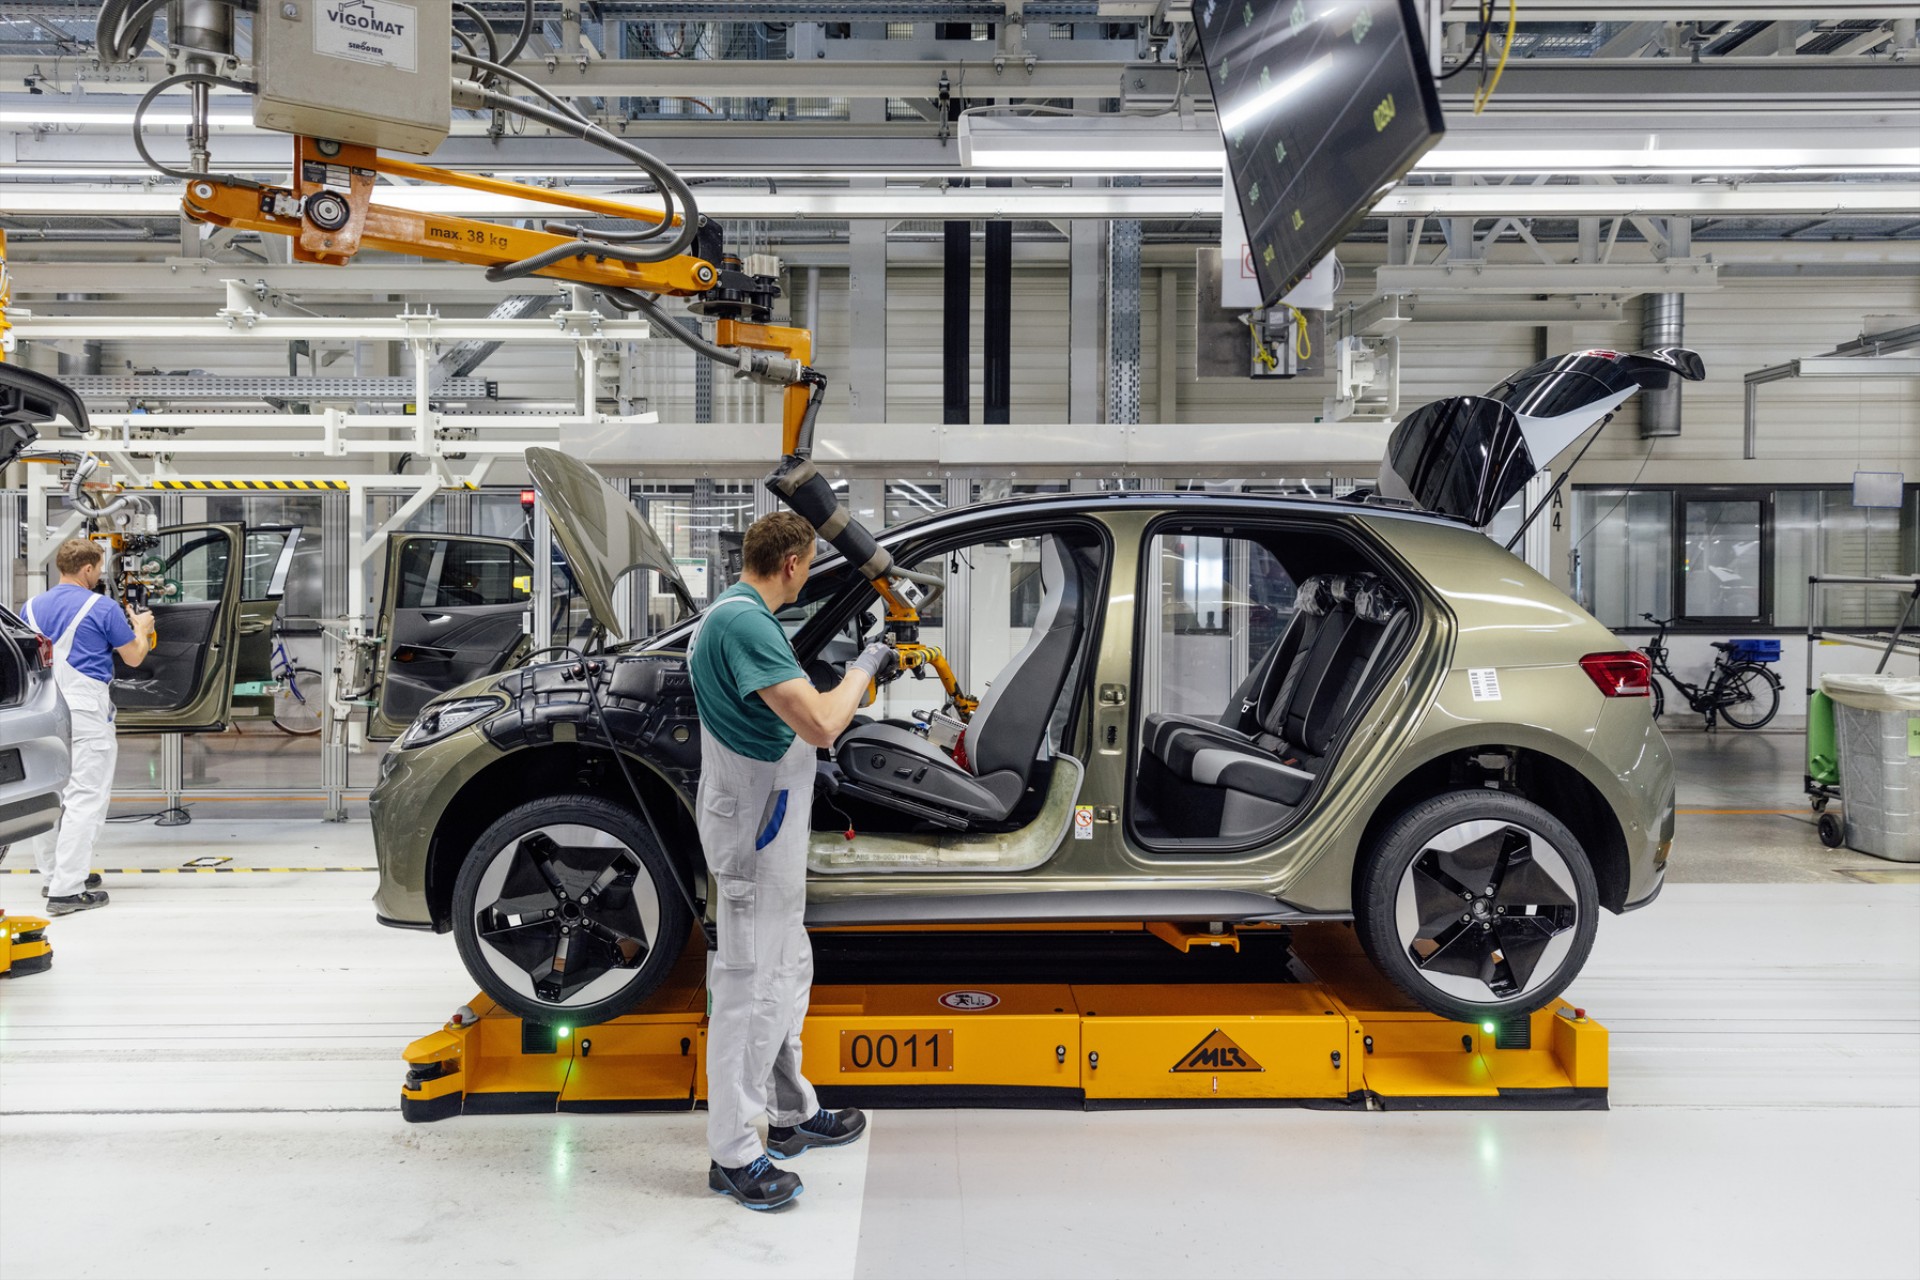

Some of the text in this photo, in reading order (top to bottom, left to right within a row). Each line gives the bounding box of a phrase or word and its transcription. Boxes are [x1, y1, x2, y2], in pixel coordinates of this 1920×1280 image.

[327, 9, 404, 36] VIGOMAT
[430, 227, 508, 250] max. 38 kg
[851, 1034, 939, 1068] 0011
